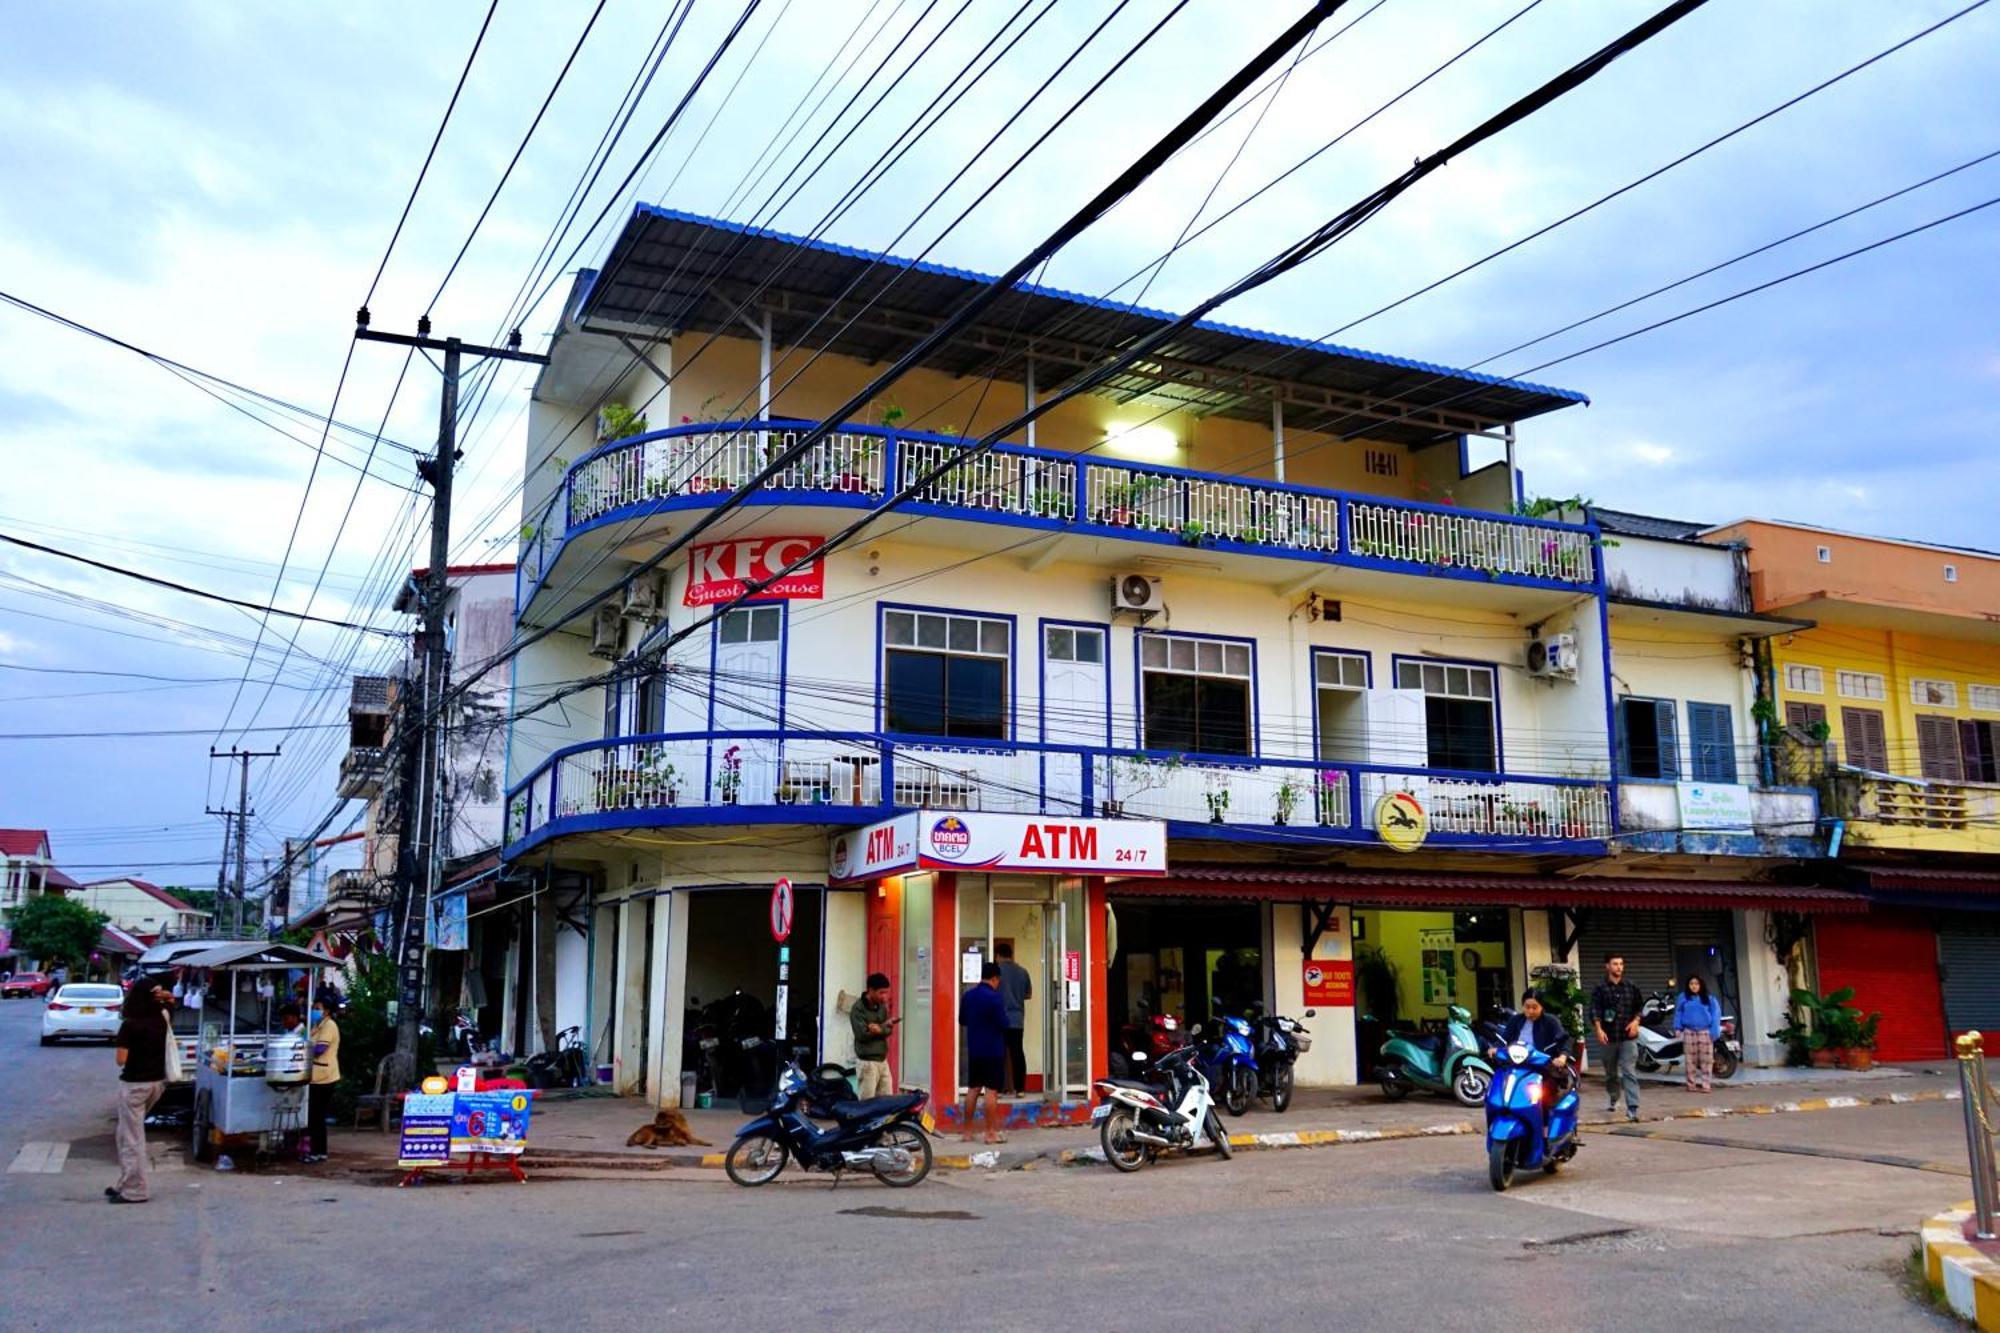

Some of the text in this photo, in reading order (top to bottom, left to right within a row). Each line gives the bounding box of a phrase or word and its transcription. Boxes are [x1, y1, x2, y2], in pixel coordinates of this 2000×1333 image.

[692, 539, 815, 585] KFC
[688, 583, 742, 606] Guest
[865, 826, 895, 865] ATM
[939, 844, 961, 853] BCEL
[1019, 824, 1098, 861] ATM
[1115, 847, 1147, 863] 24/7
[468, 1111, 486, 1137] 6
